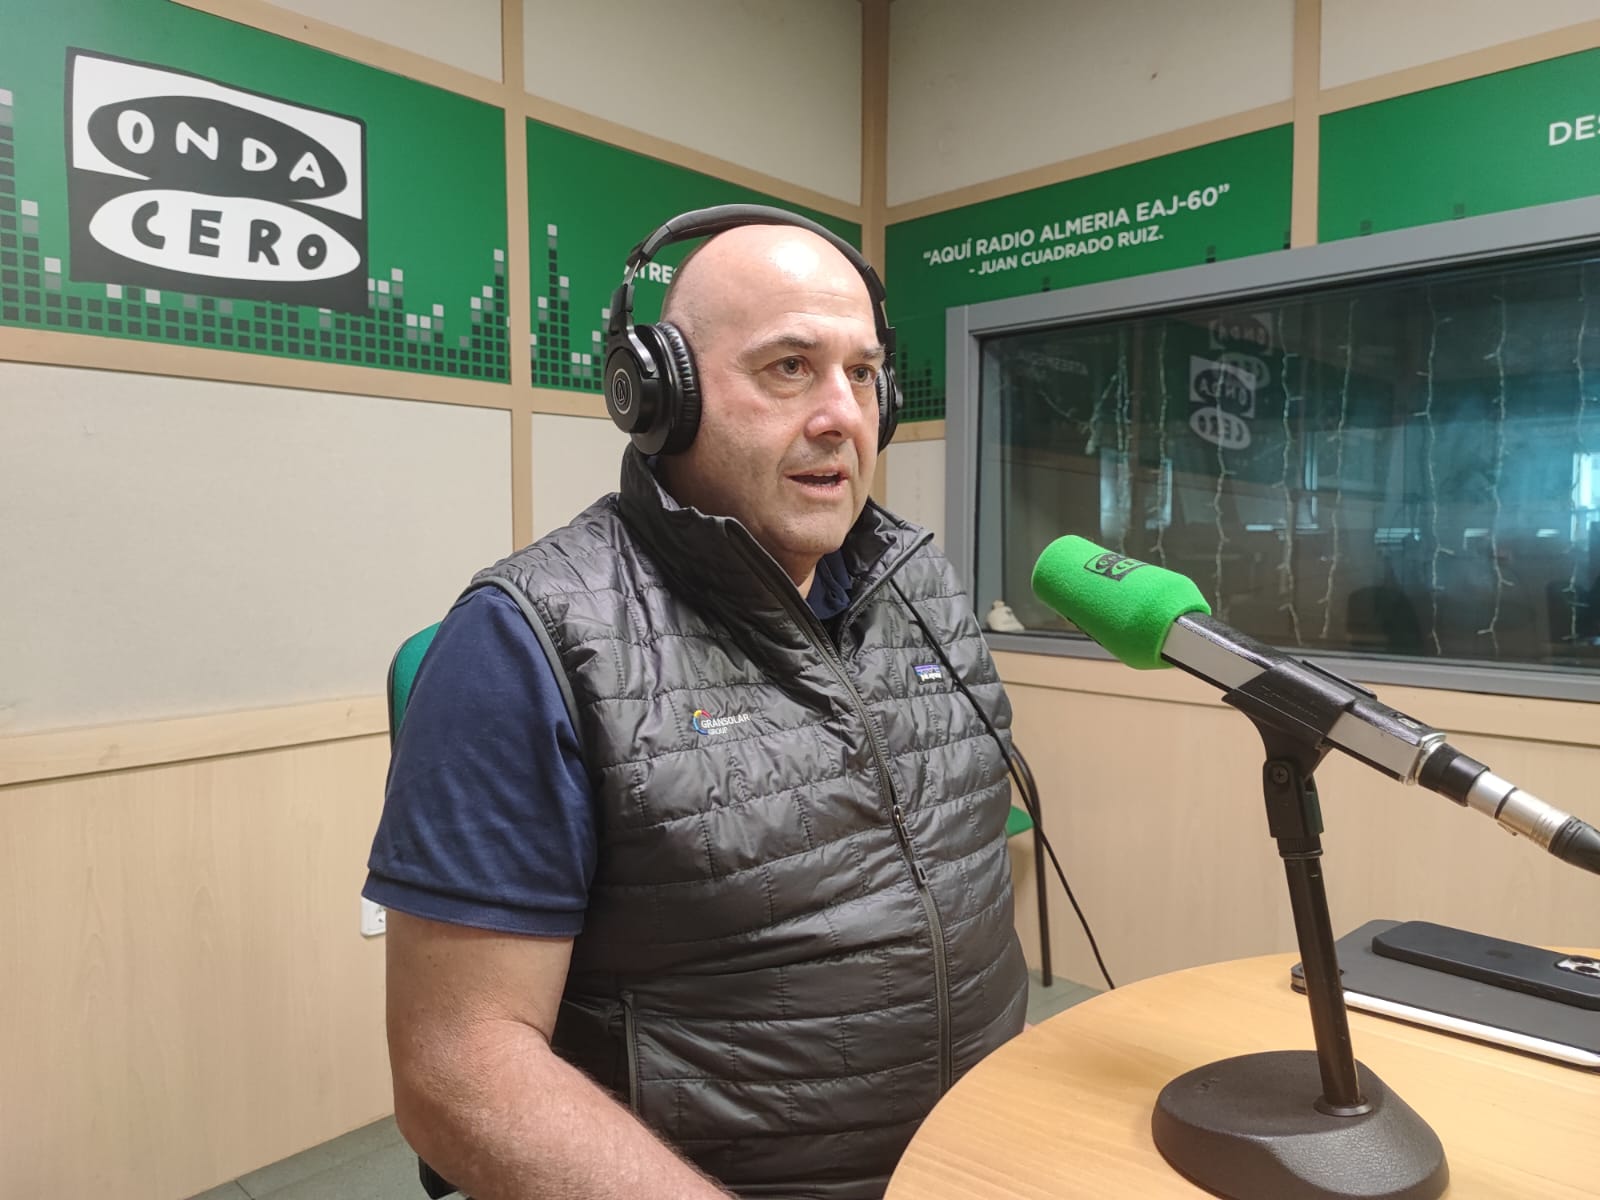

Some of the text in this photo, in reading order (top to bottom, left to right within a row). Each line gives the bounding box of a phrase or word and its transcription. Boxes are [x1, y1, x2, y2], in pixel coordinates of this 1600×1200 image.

[117, 109, 326, 189] ONDA
[1548, 113, 1600, 147] DE
[131, 200, 328, 270] CERO
[975, 228, 1035, 256] RADIO
[1039, 207, 1130, 243] ALMERIA
[978, 255, 1018, 276] JUAN
[1021, 235, 1114, 266] CUADRADO
[1117, 225, 1164, 247] RUIZ.
[700, 713, 750, 729] GRANSOLAR
